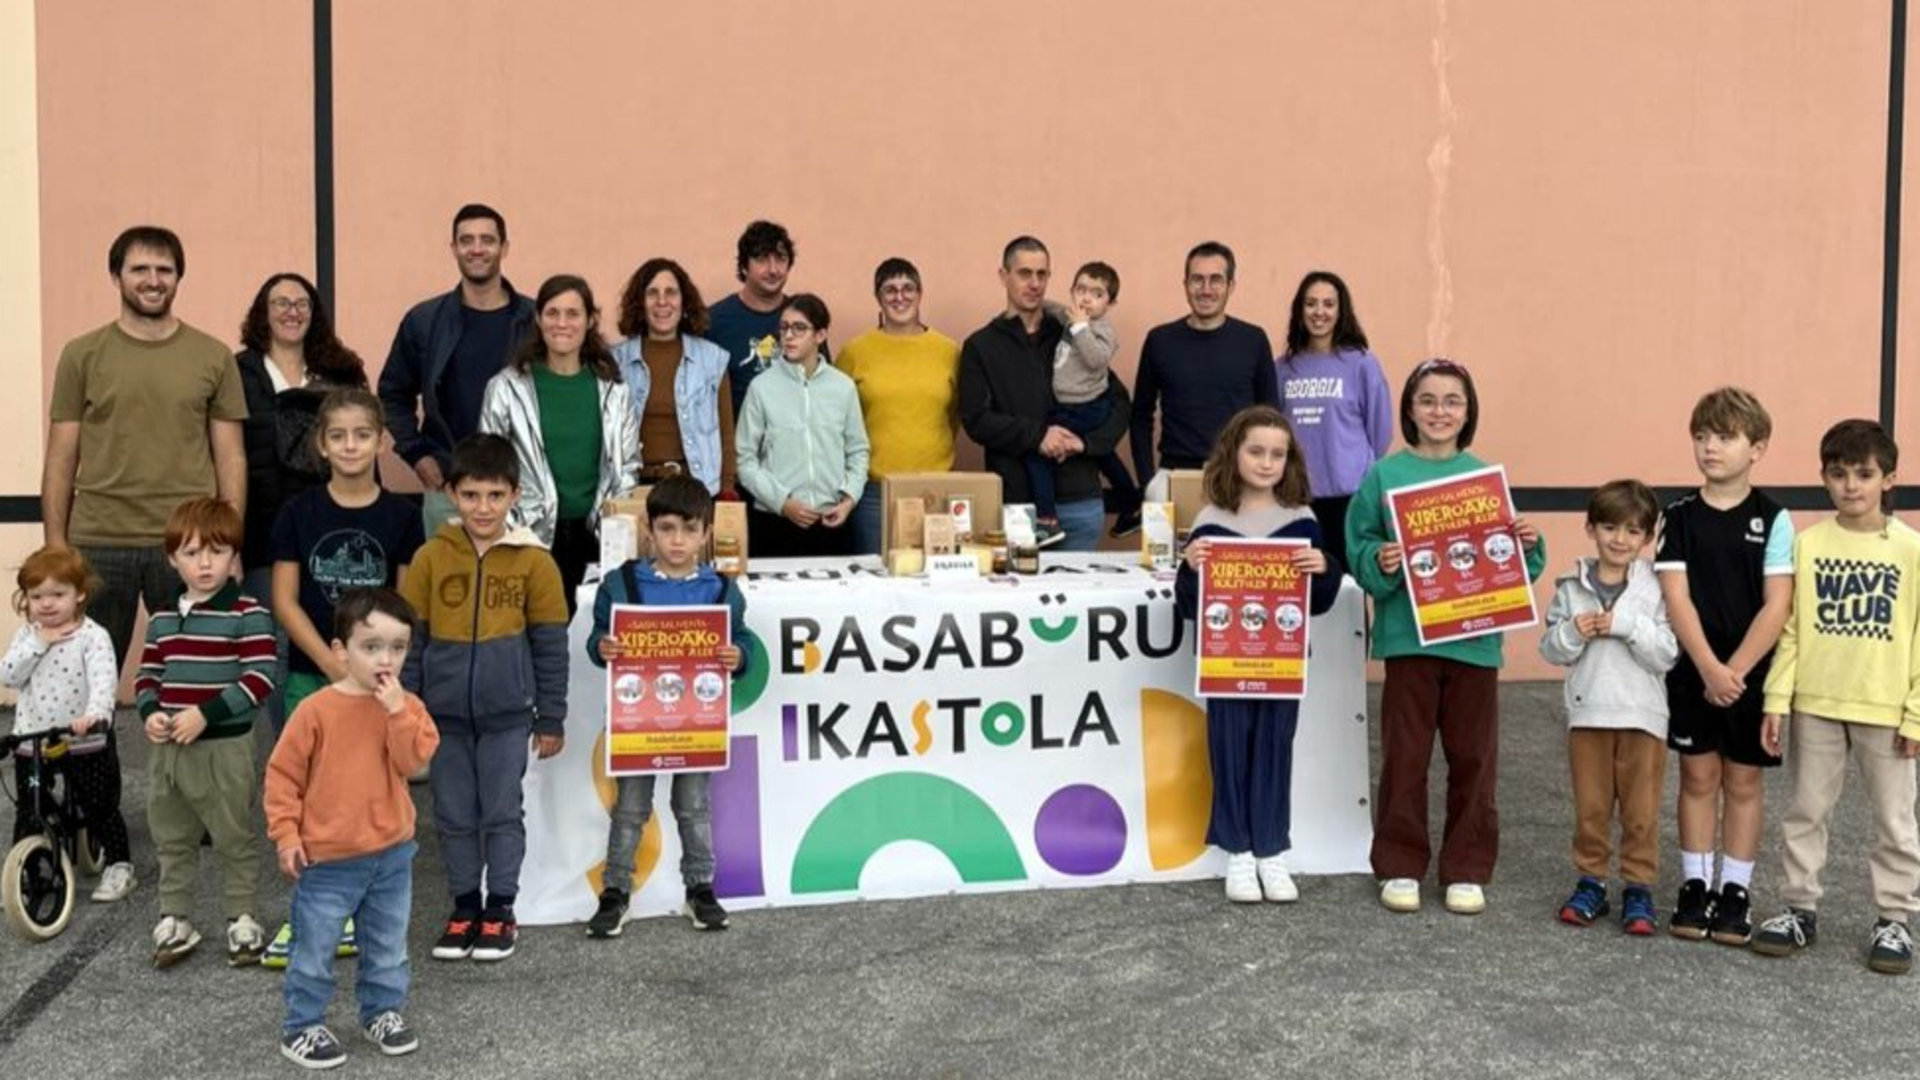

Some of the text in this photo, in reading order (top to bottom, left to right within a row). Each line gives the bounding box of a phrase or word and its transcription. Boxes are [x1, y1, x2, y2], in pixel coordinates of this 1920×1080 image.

[1815, 571, 1900, 600] WAVE
[1817, 596, 1891, 625] CLUB
[781, 690, 1120, 761] IKASTOLA
